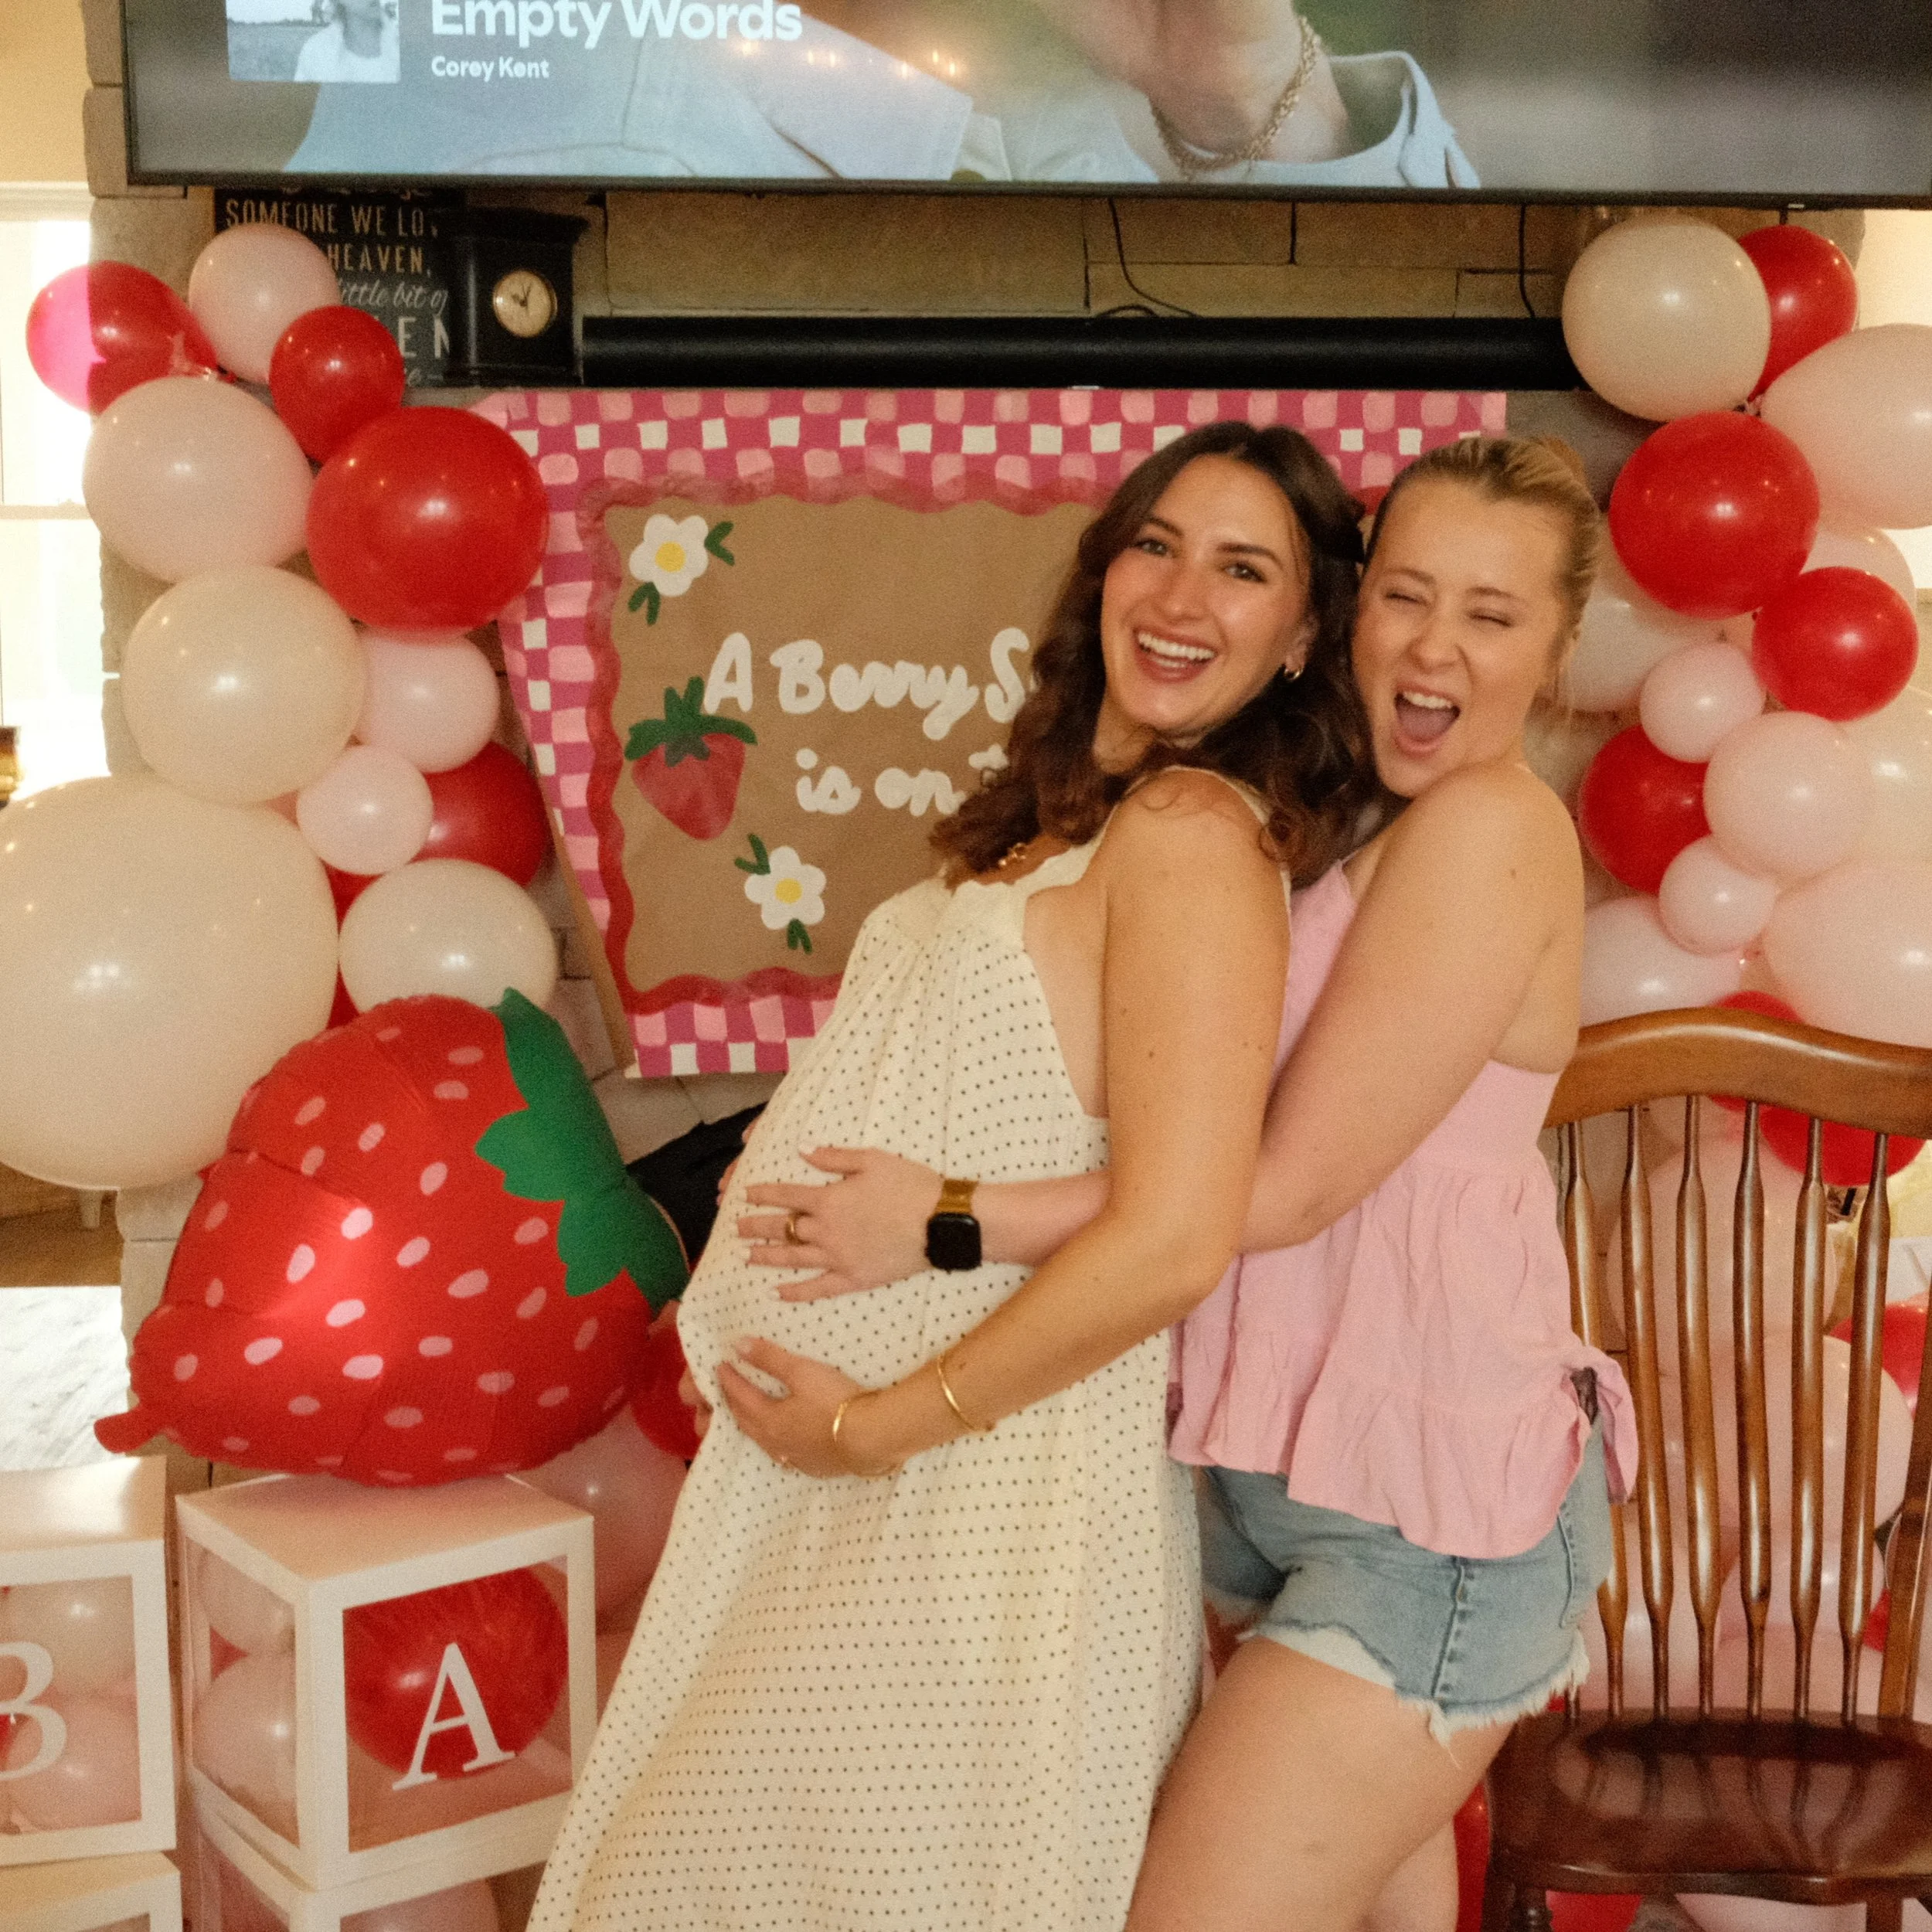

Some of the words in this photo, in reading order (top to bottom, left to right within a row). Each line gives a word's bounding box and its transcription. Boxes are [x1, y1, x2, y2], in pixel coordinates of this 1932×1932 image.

[432, 0, 613, 49] Empty
[621, 0, 803, 41] Words
[430, 56, 495, 83] Corey
[499, 56, 549, 78] Kent
[226, 198, 338, 233] SOMEONE
[351, 205, 386, 236] WE
[338, 277, 389, 307] ittle
[703, 632, 753, 715] A
[770, 638, 980, 740] Berry
[796, 747, 862, 815] is
[874, 767, 967, 817] on
[0, 1641, 68, 1778] B
[391, 1641, 516, 1791] A
